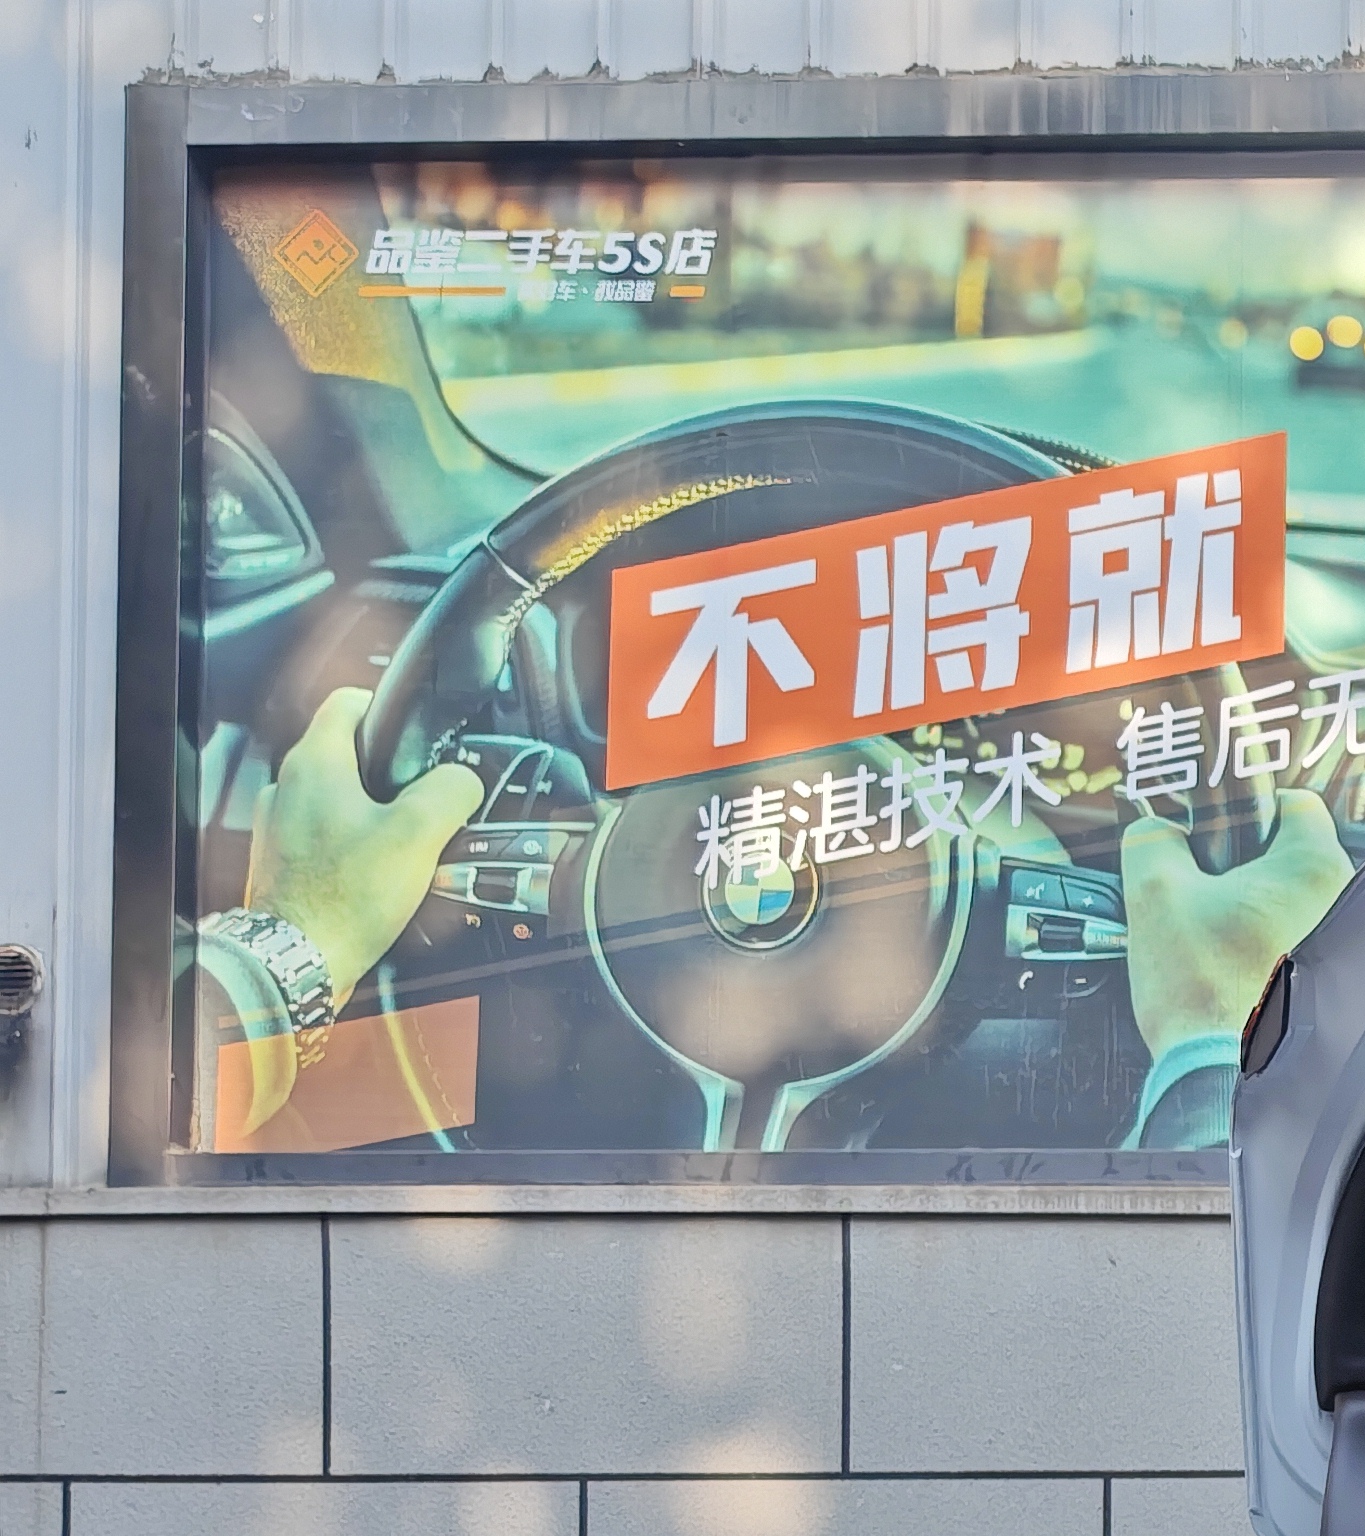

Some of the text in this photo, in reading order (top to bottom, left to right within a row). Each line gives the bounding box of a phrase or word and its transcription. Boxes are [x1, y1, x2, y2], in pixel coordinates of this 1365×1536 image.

[365, 228, 718, 276] 品鉴二手车5S店
[646, 469, 1242, 748] 不将就
[693, 729, 1062, 890] 精湛技术
